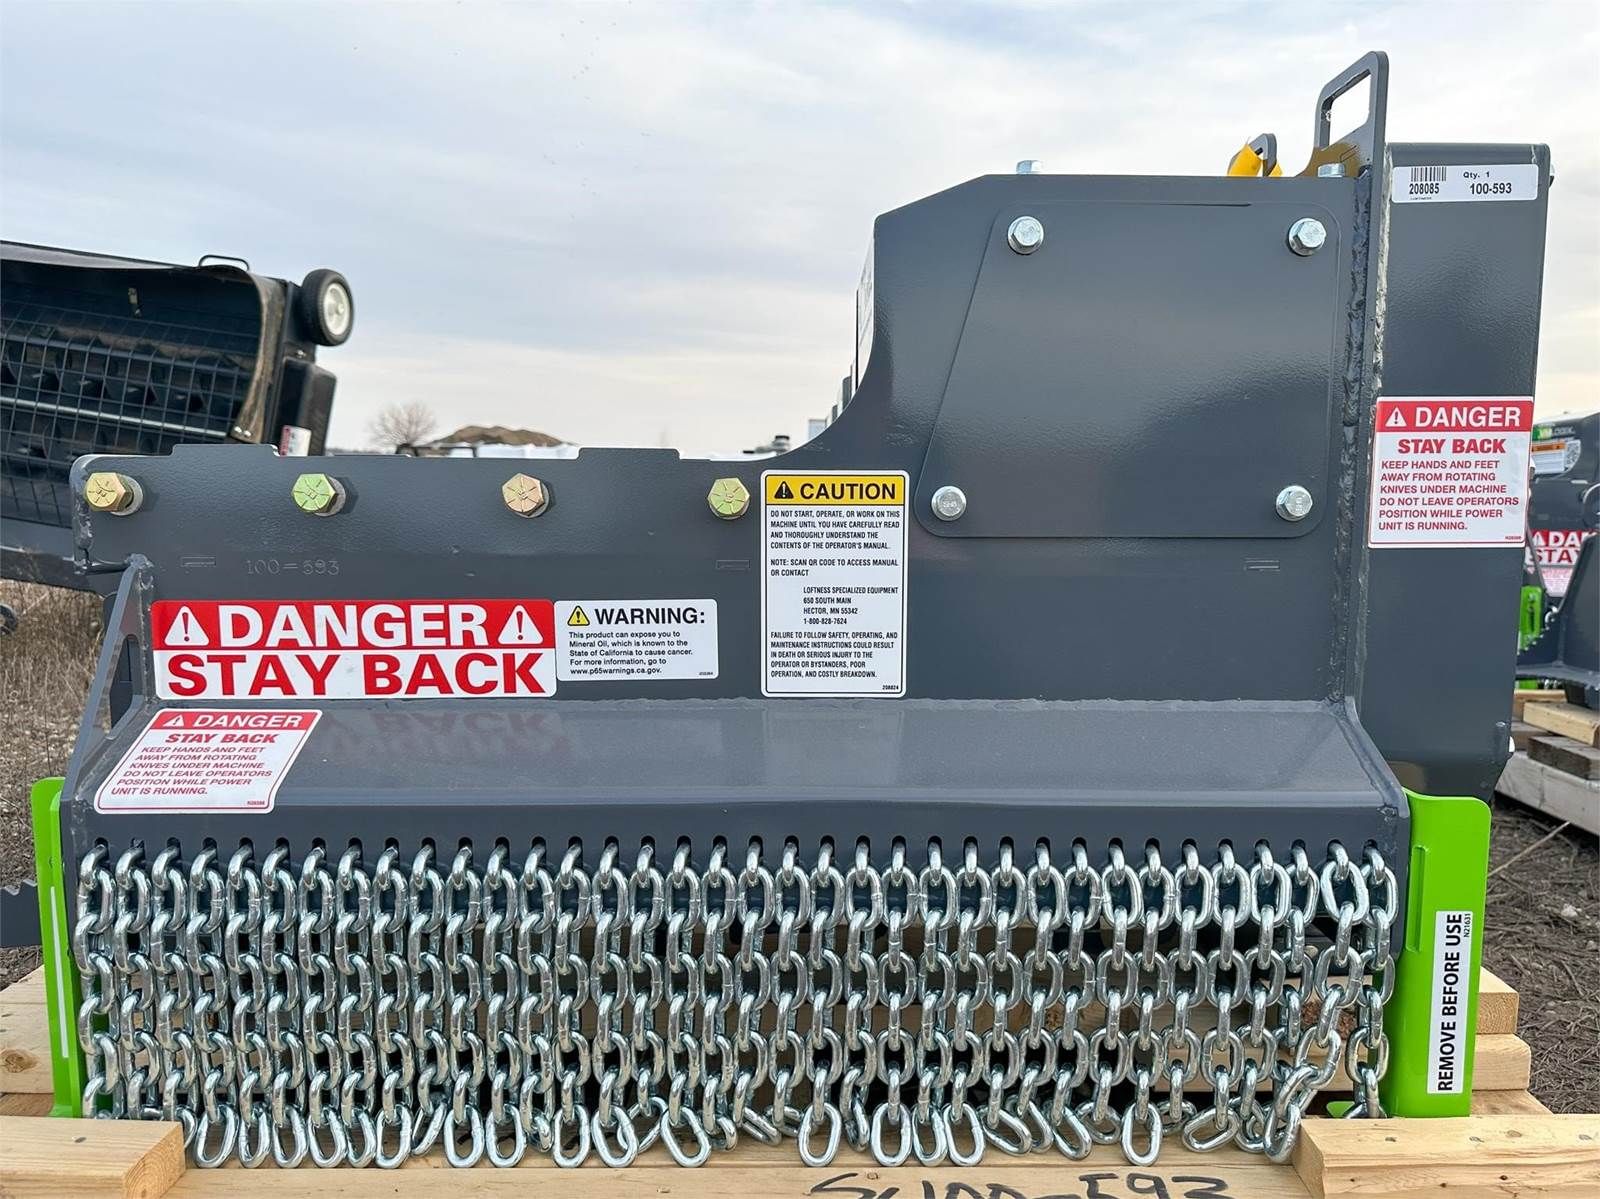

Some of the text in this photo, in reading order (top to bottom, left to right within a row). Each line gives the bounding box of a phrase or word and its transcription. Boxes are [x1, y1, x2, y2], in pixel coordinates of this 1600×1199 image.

[1463, 171, 1480, 179] Qty.
[1409, 183, 1440, 195] 208085
[1469, 182, 1512, 194] 100-593
[1415, 407, 1520, 427] DANGER
[1398, 439, 1506, 454] STAY BACK
[1381, 460, 1500, 469] KEEP HANDS AND FEET
[1380, 473, 1495, 481] AWAY FROM ROTATING
[800, 483, 895, 500] CAUTION
[1380, 485, 1506, 493] KNIVES UNDER MACHINE
[1379, 497, 1519, 506] DO NOT LEAVE OPERATORS
[770, 510, 900, 518] DO NOT START, OPERATE, OR WORK ON THIS
[1379, 509, 1503, 518] POSITION WHILE POWER
[1378, 522, 1467, 530] UNIT IS RUNNING.
[770, 531, 878, 539] AND THOROUGHLY UNDERSTAND THE
[246, 559, 340, 576] 100-593
[770, 569, 808, 577] OR CONTACT
[594, 607, 704, 624] WARNING:
[218, 604, 488, 647] DANGER
[585, 631, 613, 640] product
[569, 640, 595, 648] Mineral
[597, 640, 609, 648] Oil,
[611, 640, 632, 648] which
[642, 639, 665, 647] known
[667, 639, 674, 647] to
[676, 639, 688, 647] the
[771, 641, 894, 649] MAINTENANCE INSTRUCTIONS COULD RESULT
[590, 649, 597, 657] of
[599, 649, 633, 657] California
[603, 658, 646, 666] information,
[168, 652, 545, 696] STAY BACK
[570, 667, 661, 675] www.p65warnings.ca.gov.
[192, 715, 303, 728] DANGER
[165, 734, 278, 743] STAY BACK
[1463, 913, 1471, 938] N21631
[1438, 914, 1462, 1091] REMOVE BEFORE USE
